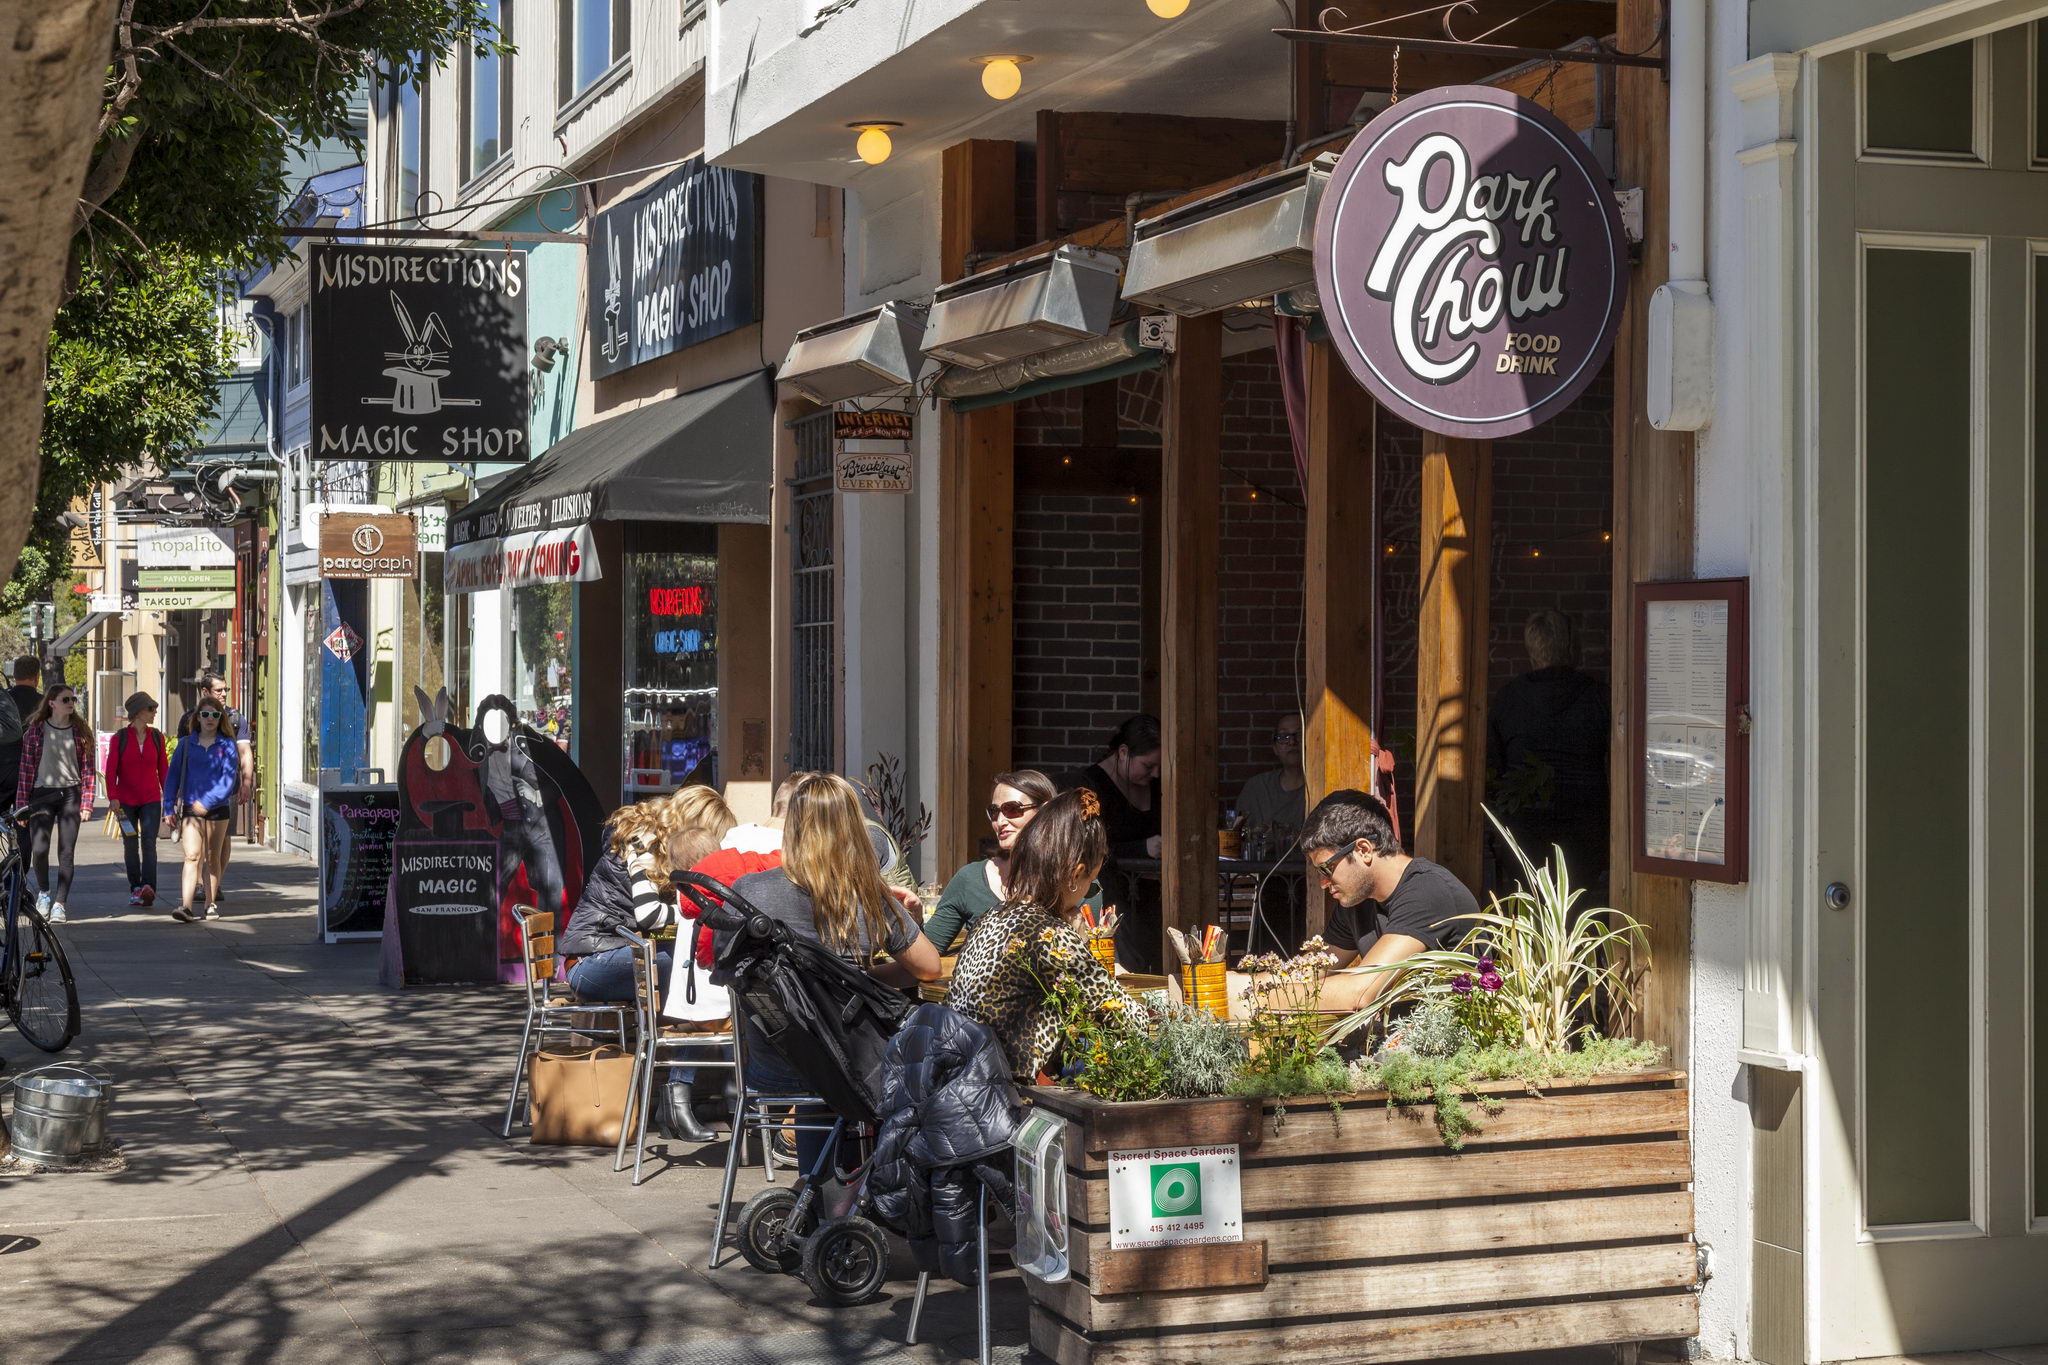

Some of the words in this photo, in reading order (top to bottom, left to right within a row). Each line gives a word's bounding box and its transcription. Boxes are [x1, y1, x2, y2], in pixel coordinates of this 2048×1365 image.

[1366, 133, 1558, 296] Park
[632, 166, 738, 297] MISDIRECTIONS
[318, 253, 522, 297] MISDIRECTIONS
[637, 280, 684, 348] MAGIC
[688, 259, 732, 329] SHOP
[1393, 218, 1566, 378] Chow
[1505, 333, 1561, 354] FOOD
[1496, 354, 1558, 375] DRINK
[838, 413, 910, 427] INTERNET
[320, 423, 419, 456] MAGIC
[442, 426, 523, 457] SHOP
[843, 460, 905, 480] Breakfast
[842, 480, 907, 489] EVERYDAY
[551, 492, 592, 523] ILLUSIONS
[152, 536, 222, 557] nopalito
[323, 555, 412, 571] paragraph
[534, 541, 580, 577] COMING
[144, 598, 192, 606] TAKEOUT
[401, 856, 493, 875] MISDIRECTIONS
[418, 879, 477, 894] MAGIC
[1112, 1151, 1151, 1162] Sacred
[1153, 1149, 1187, 1160] Space
[1190, 1146, 1236, 1157] Gardens
[1150, 1224, 1163, 1233] 415
[1167, 1223, 1181, 1231] 412
[1184, 1221, 1205, 1230] 4495
[1115, 1234, 1240, 1249] www.sacredspacegardens.com
